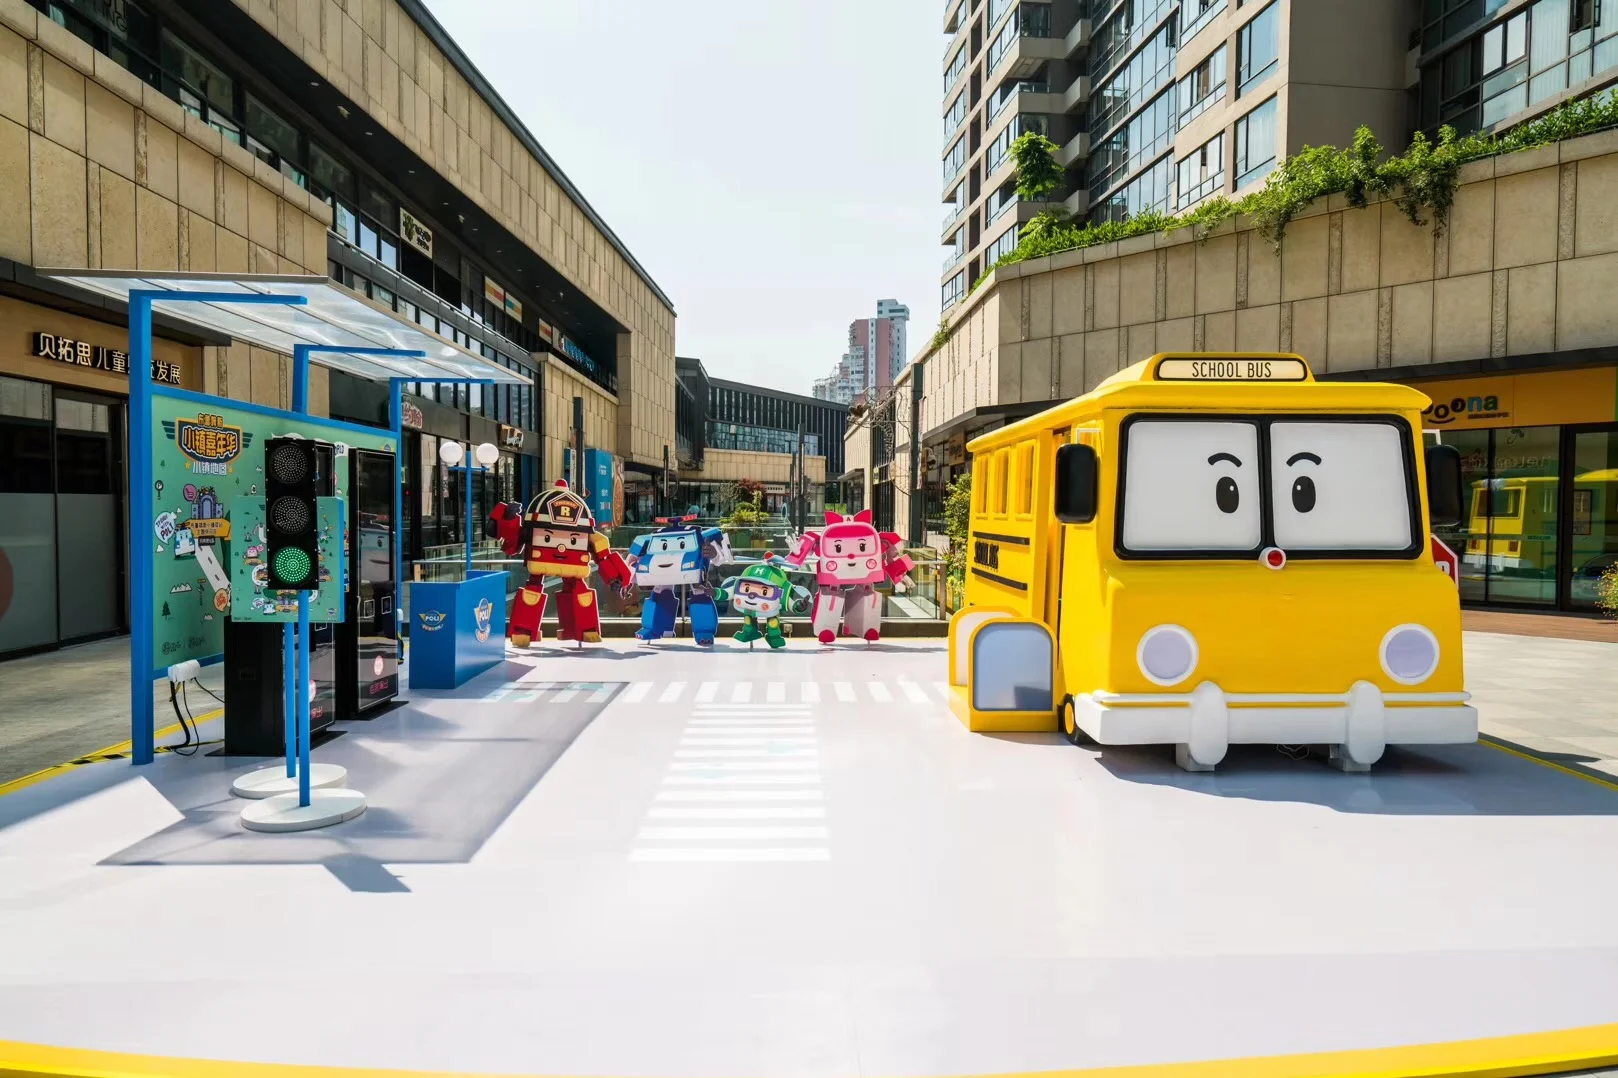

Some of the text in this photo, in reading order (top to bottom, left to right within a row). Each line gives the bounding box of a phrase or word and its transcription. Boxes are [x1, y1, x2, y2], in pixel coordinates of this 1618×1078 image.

[1191, 361, 1272, 378] SCHOOL BUS
[183, 427, 237, 457] 小镇嘉年华
[192, 461, 227, 476] 小镇地图
[560, 505, 571, 517] R
[755, 567, 765, 575] H
[479, 608, 489, 621] POLI
